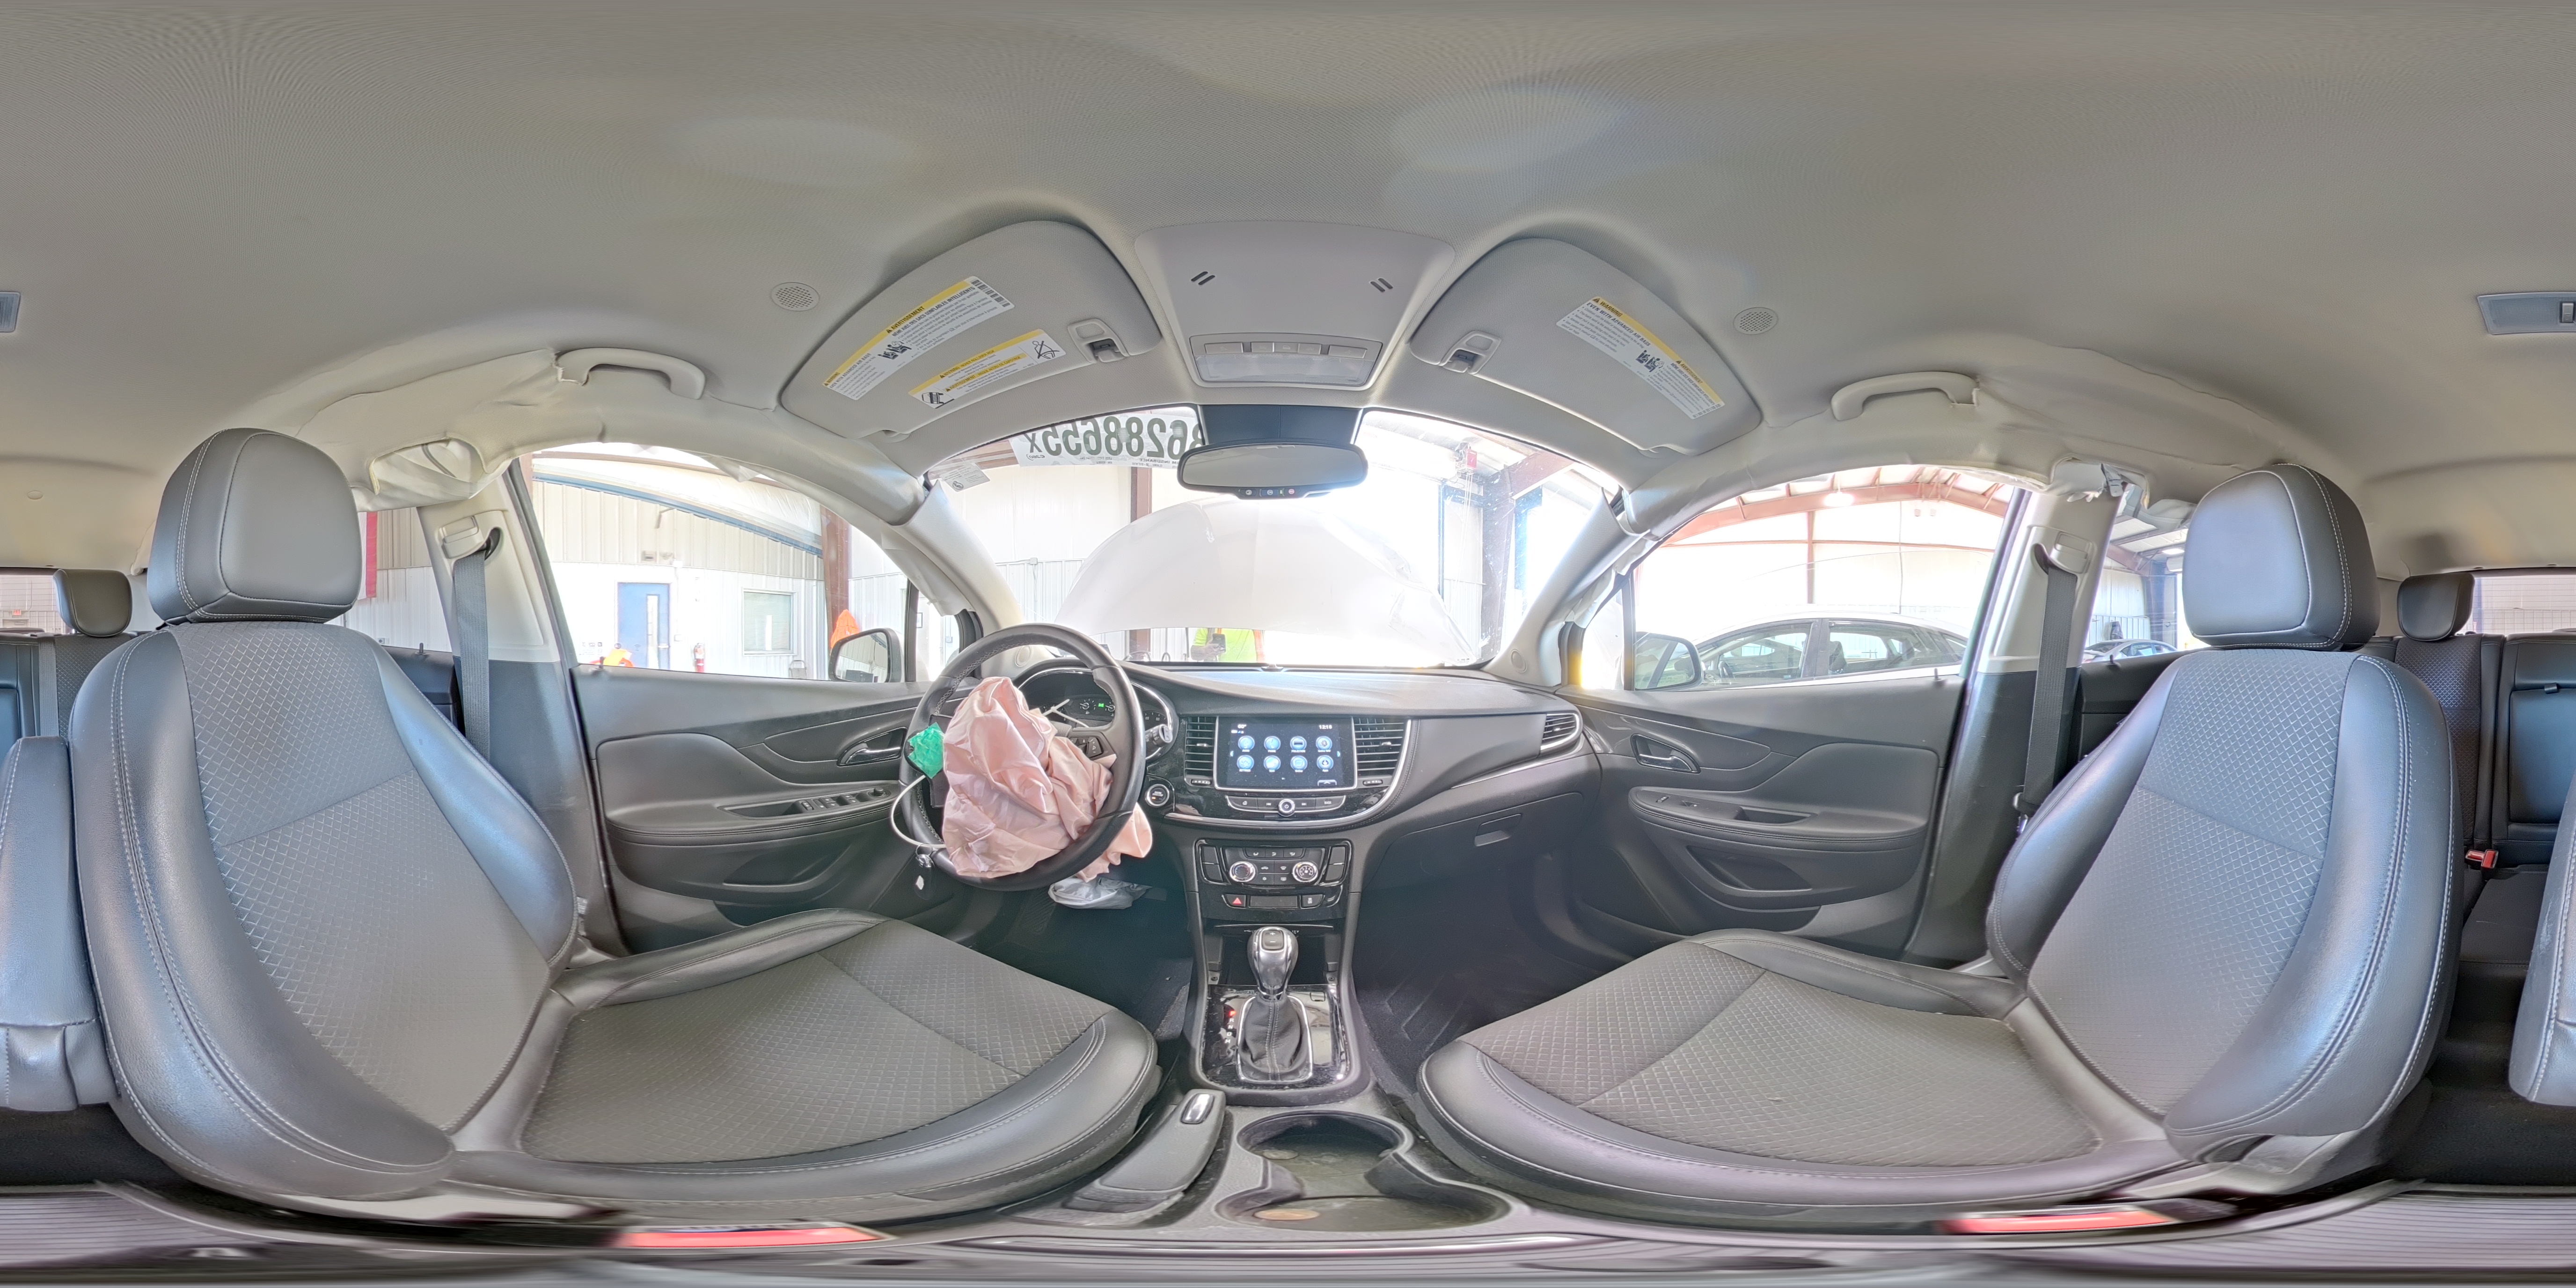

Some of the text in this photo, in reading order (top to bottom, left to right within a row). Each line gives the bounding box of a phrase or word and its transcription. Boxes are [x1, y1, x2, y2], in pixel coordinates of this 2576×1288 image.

[947, 287, 975, 302] INTELLIGENTS
[891, 306, 925, 329] AVERTISSEMENT
[1600, 301, 1623, 317] WARNING
[1587, 302, 1599, 311] EVEN
[1599, 310, 1612, 319] WITH
[1612, 318, 1633, 334] ADVANCED
[1640, 337, 1651, 347] BAGS
